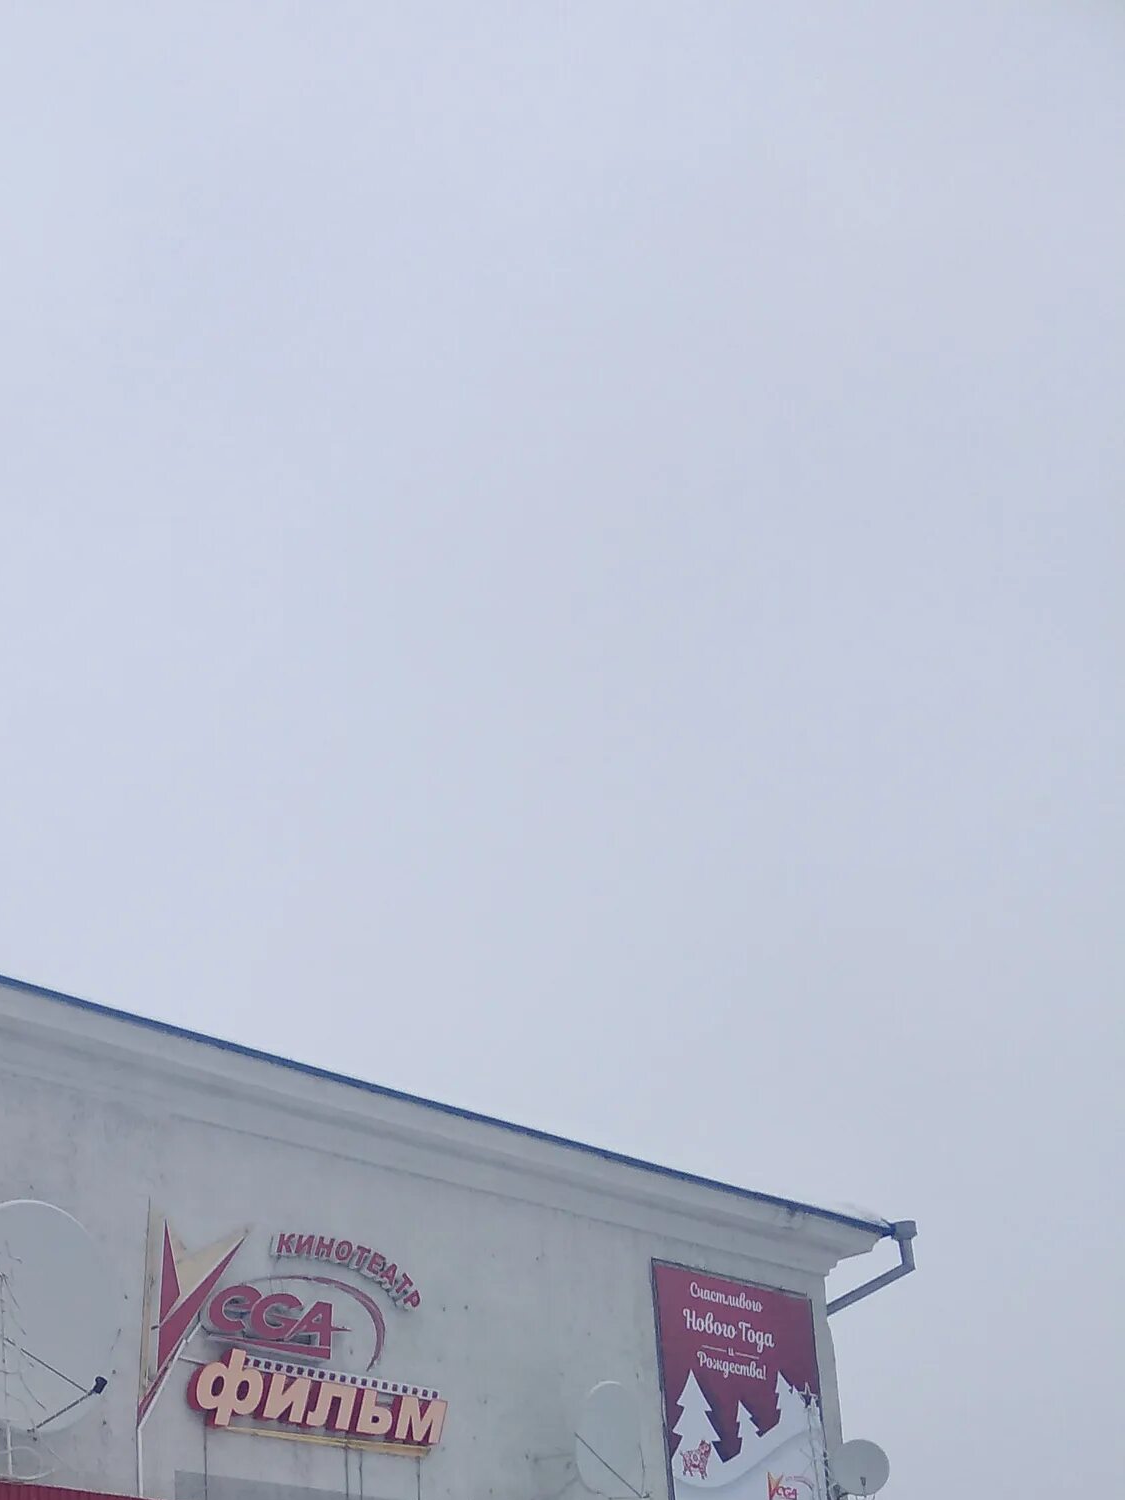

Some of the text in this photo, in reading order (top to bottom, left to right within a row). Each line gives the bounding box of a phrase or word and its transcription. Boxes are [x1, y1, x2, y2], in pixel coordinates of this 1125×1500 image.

[275, 1232, 422, 1310] КИНОТЕАТР
[690, 1281, 763, 1313] Счастливого
[683, 1308, 775, 1353] Нового Года
[697, 1350, 767, 1380] Рождества!
[727, 1347, 735, 1356] и
